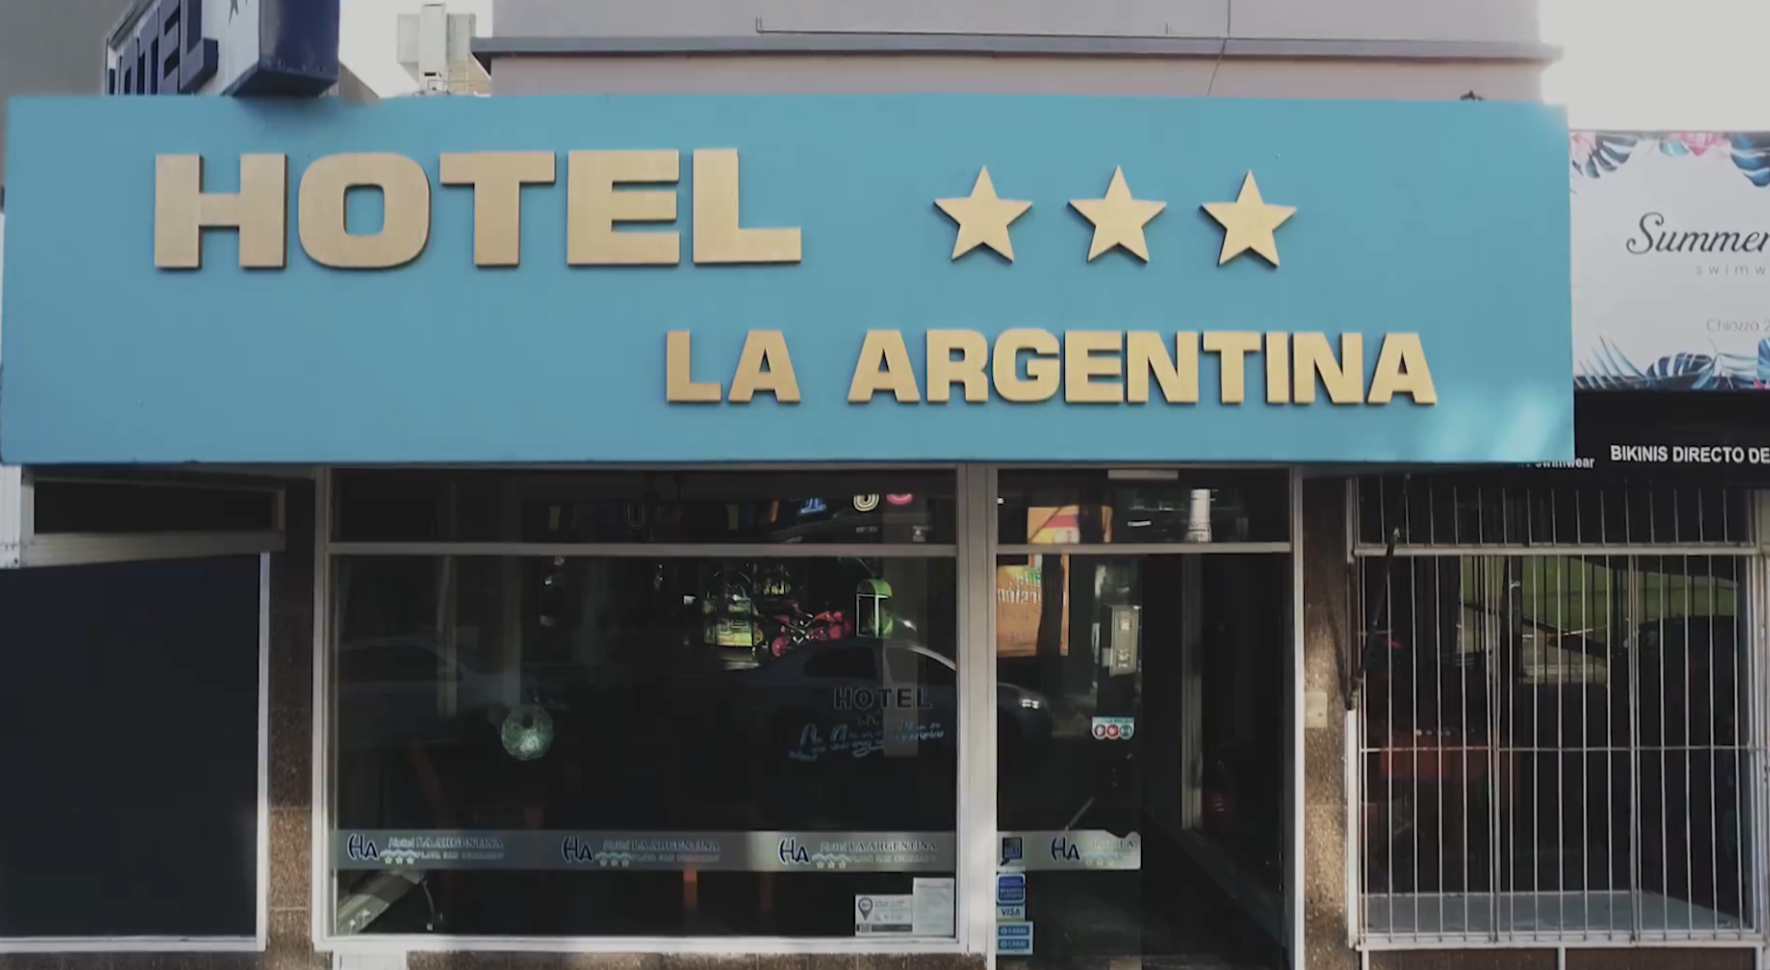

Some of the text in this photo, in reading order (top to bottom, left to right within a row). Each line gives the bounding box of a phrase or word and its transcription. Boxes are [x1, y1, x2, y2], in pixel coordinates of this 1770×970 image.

[153, 148, 802, 269] HOTEL
[1625, 212, 1770, 255] Summer
[666, 329, 1438, 405] LA ARGENTINA
[1610, 444, 1669, 462] BIKINIS
[1672, 446, 1745, 464] DIRECTO
[833, 686, 933, 710] HOTEL
[1001, 908, 1021, 916] VISA
